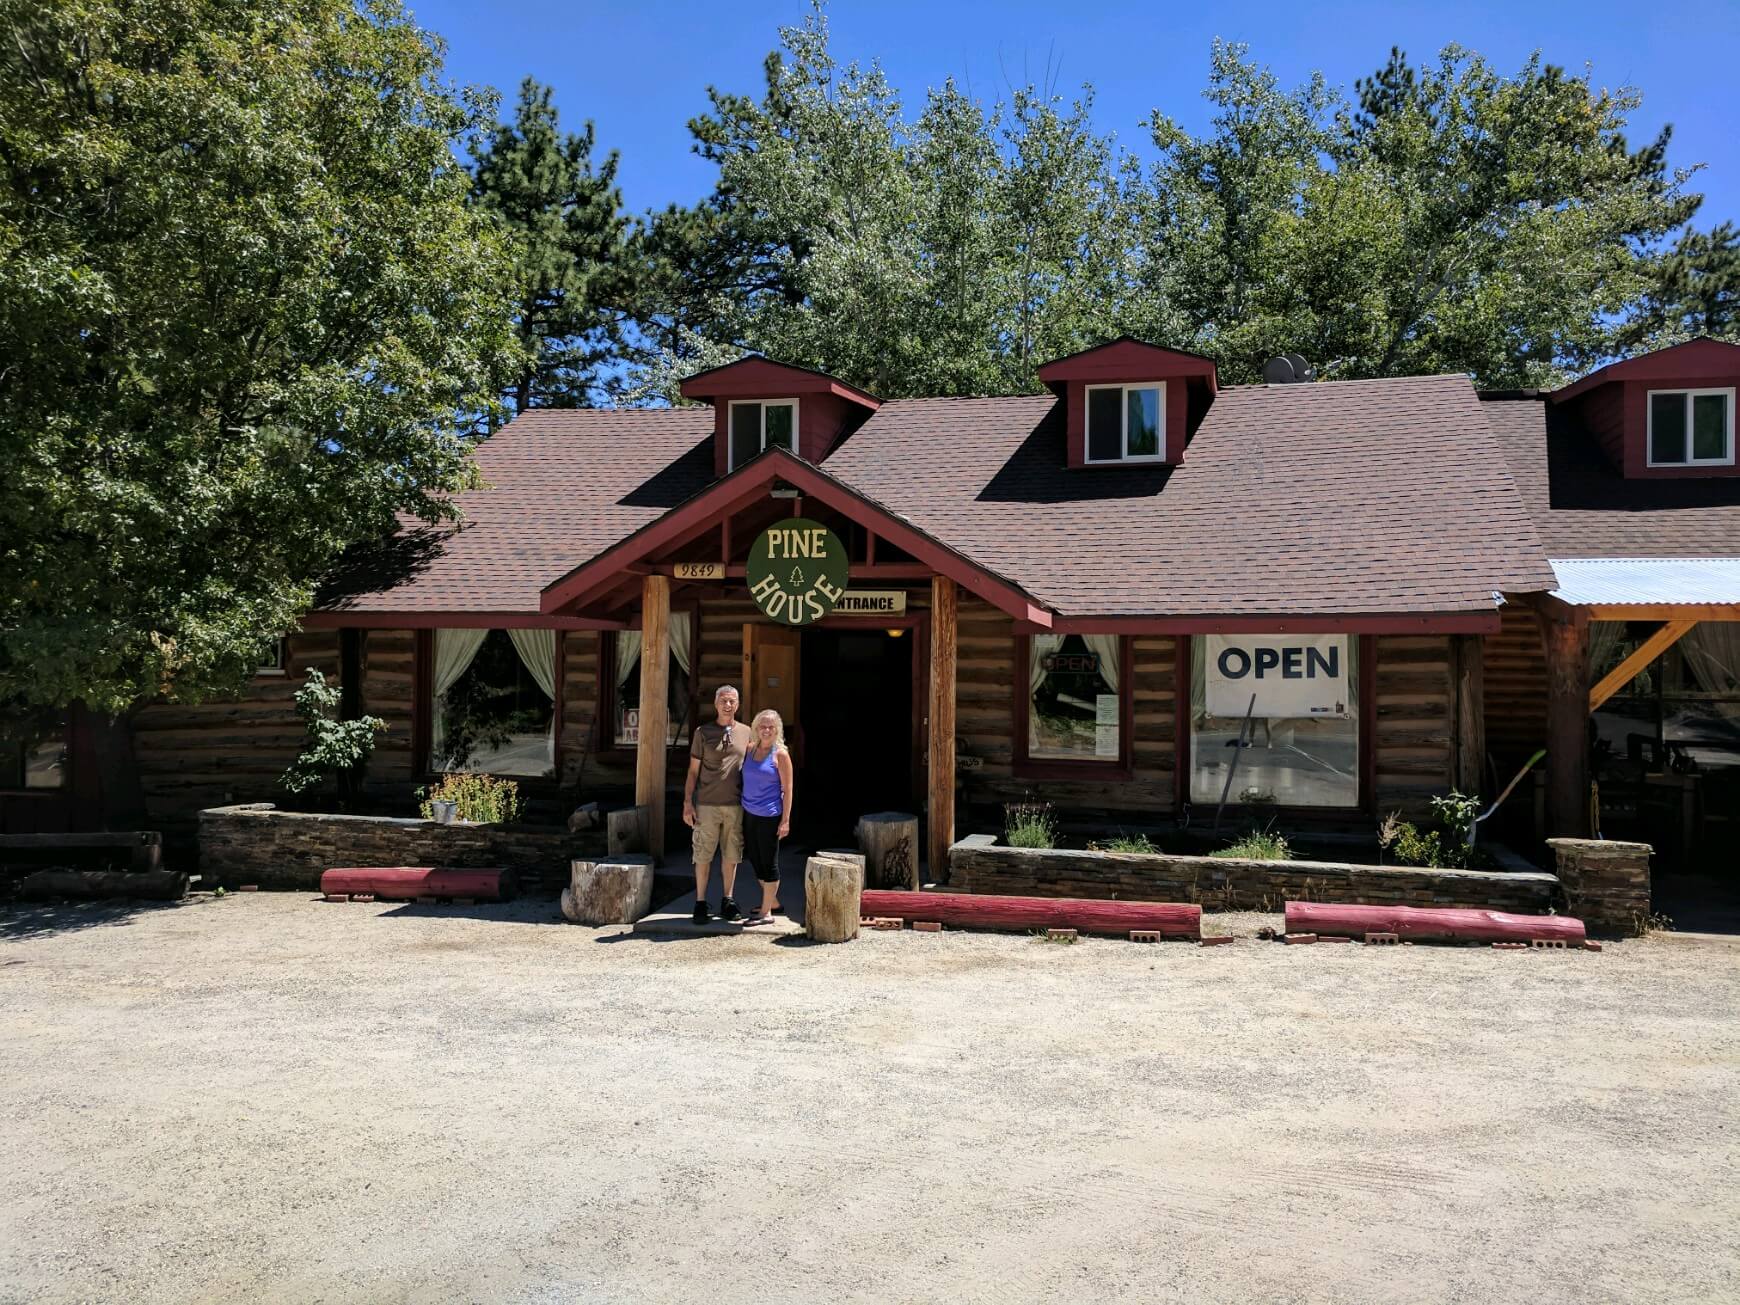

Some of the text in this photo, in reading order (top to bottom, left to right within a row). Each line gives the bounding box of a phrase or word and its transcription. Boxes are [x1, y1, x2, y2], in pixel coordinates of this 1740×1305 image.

[767, 529, 827, 559] PINE
[682, 563, 714, 577] 9849
[750, 573, 843, 624] HOUSE
[835, 597, 894, 610] NTRANCE
[1217, 646, 1339, 679] OPEN
